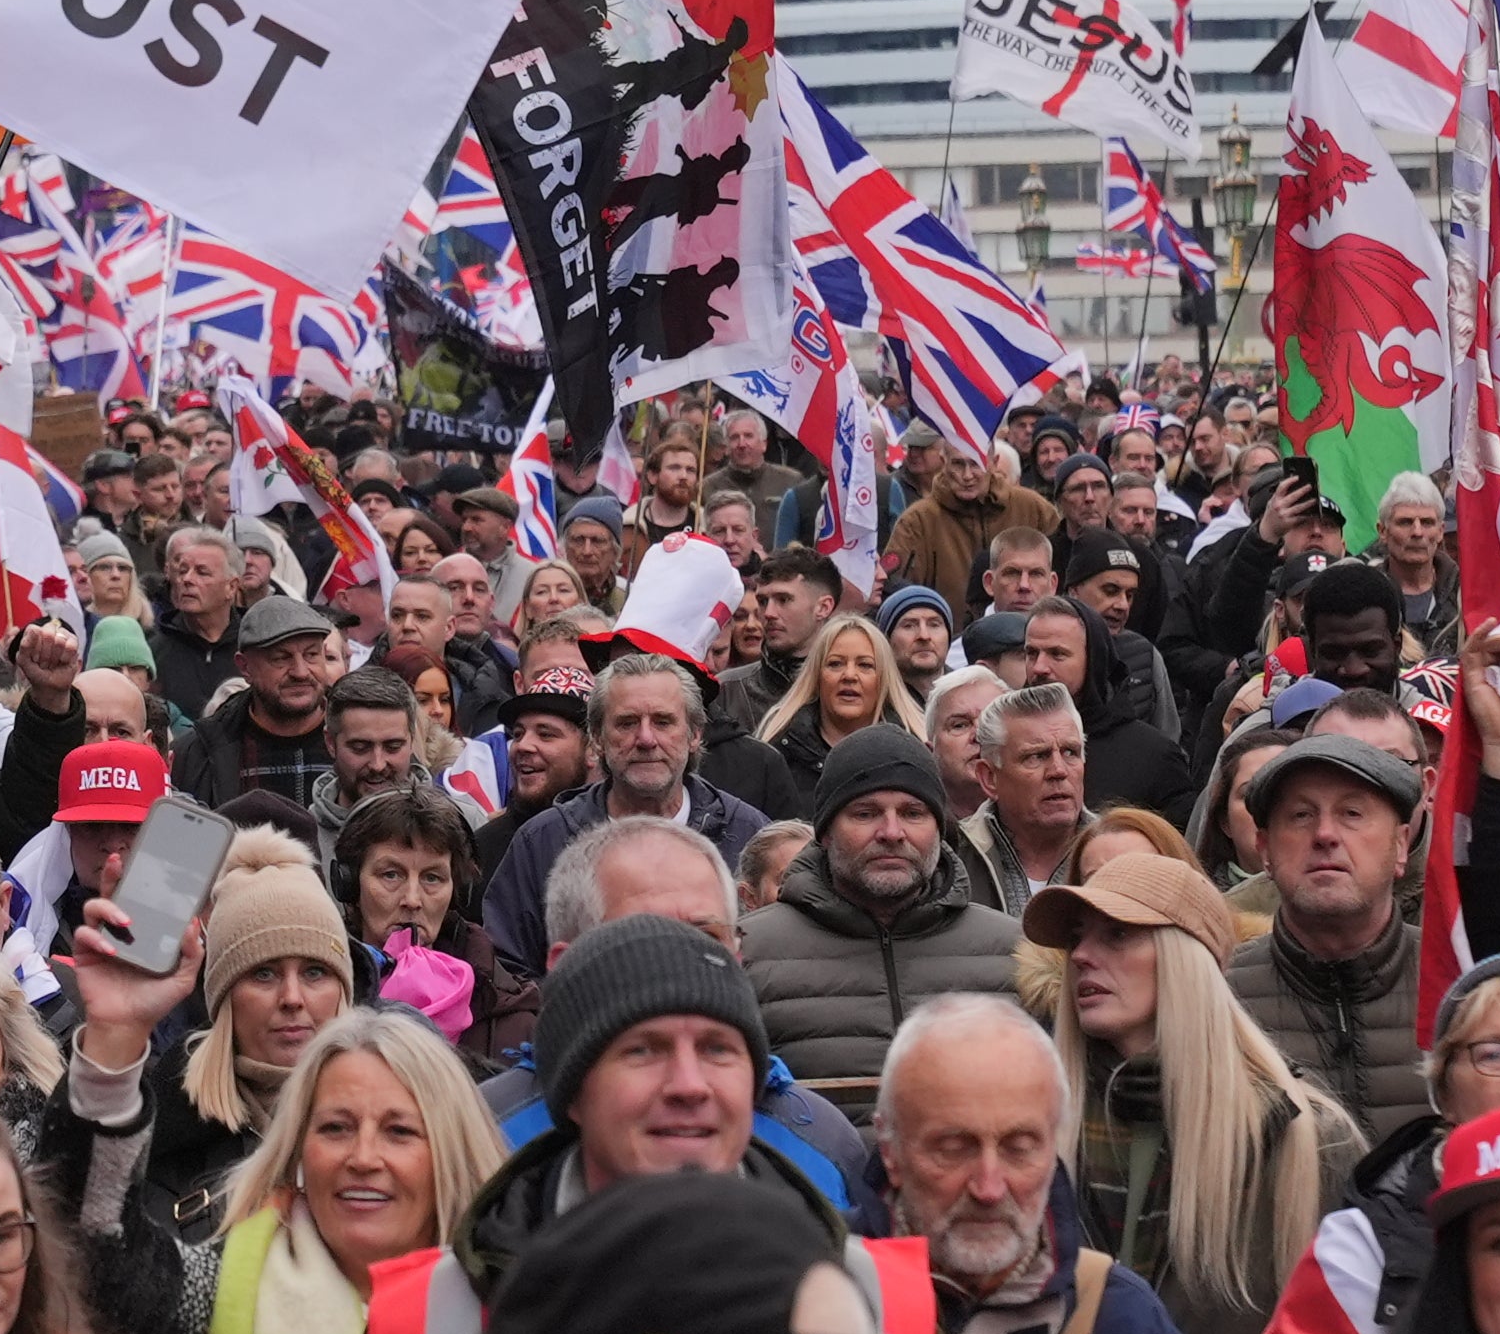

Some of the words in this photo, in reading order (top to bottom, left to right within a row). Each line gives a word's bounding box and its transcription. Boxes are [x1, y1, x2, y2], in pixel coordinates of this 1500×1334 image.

[962, 19, 992, 43] THE
[996, 31, 1036, 60] WAY
[1044, 52, 1074, 73] THE
[1073, 56, 1126, 83] TRUTH
[1130, 81, 1159, 114] THE
[1160, 108, 1191, 140] LIFE
[490, 46, 600, 322] FORGET
[407, 407, 473, 438] FREE
[79, 767, 141, 791] MEGA
